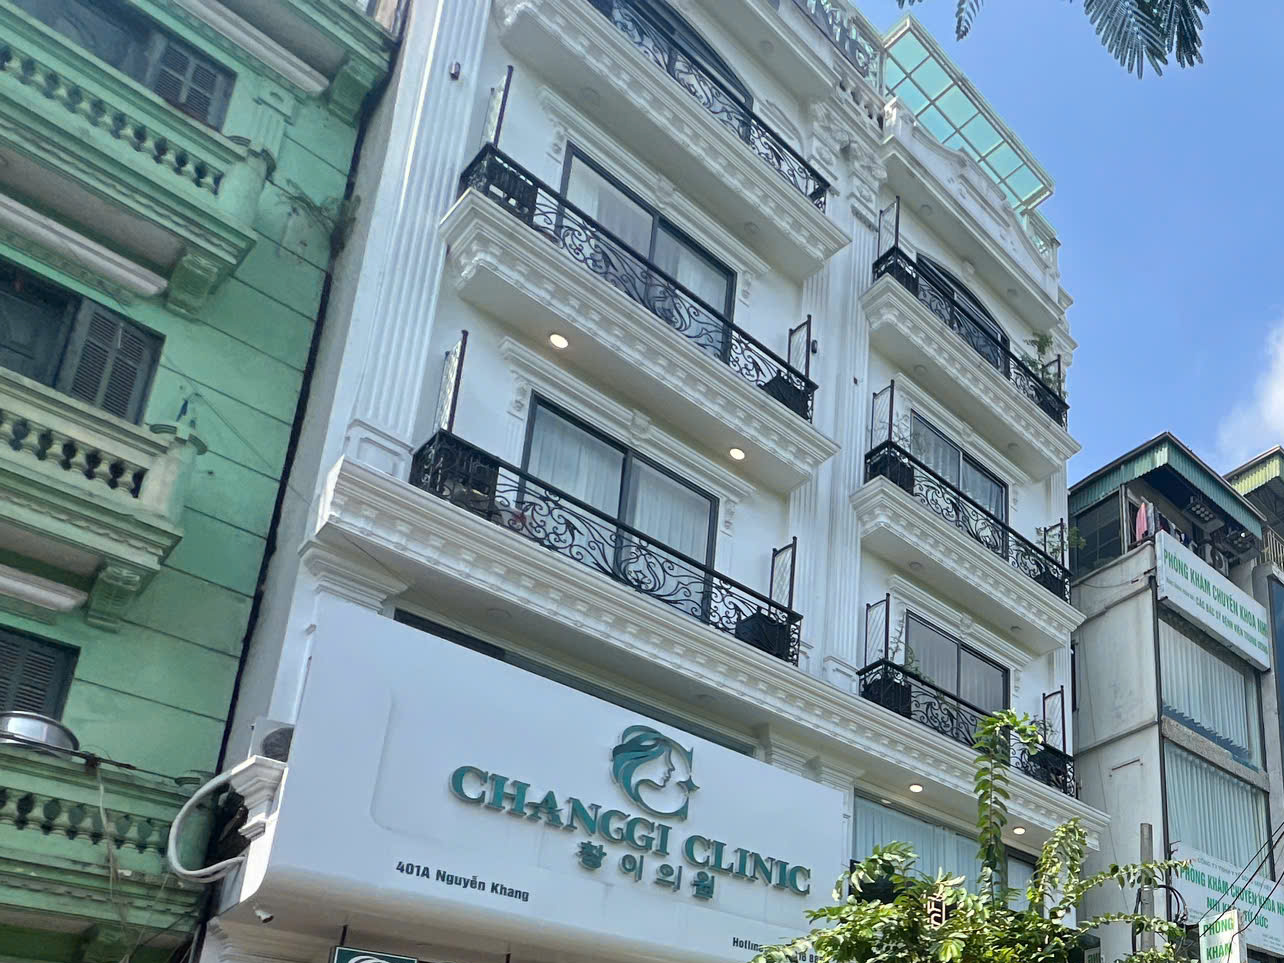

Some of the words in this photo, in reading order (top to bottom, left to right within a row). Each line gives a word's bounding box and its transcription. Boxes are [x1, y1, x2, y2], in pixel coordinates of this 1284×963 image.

[1164, 548, 1188, 580] PHÒNG
[1190, 568, 1211, 597] KHÁM
[1212, 585, 1238, 617] CHUYÊN
[1240, 603, 1256, 629] KHOA
[449, 765, 673, 856] CHANGGI
[681, 834, 812, 897] CLINIC
[396, 861, 430, 879] 401A
[435, 869, 486, 891] Nguyễn
[490, 882, 530, 902] Khang
[1180, 863, 1205, 886] PHÒNG
[1208, 875, 1229, 896] KHÁM
